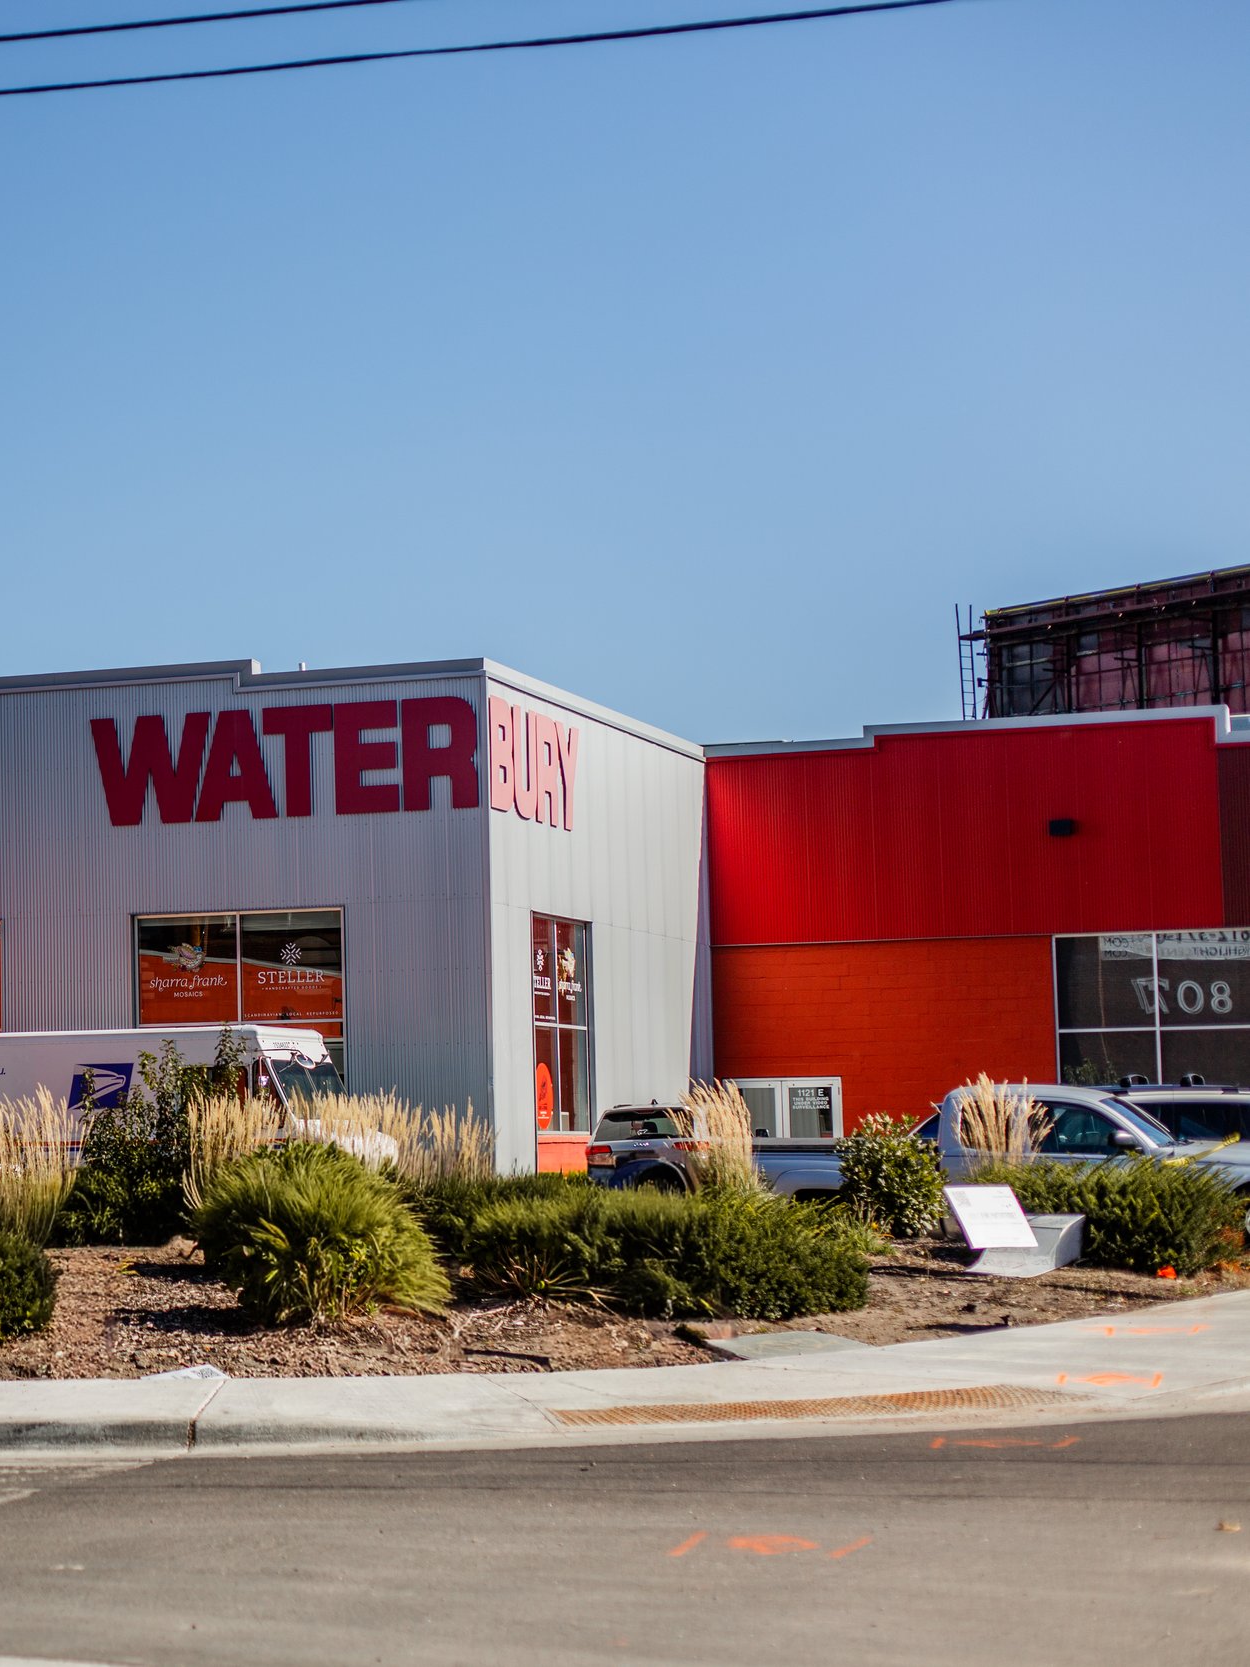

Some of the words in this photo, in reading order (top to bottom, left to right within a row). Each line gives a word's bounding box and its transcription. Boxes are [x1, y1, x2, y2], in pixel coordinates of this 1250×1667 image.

[90, 696, 479, 826] WATER
[488, 694, 579, 831] BURY
[149, 977, 188, 992] sharra
[189, 975, 228, 990] frank
[257, 969, 325, 984] STELLER
